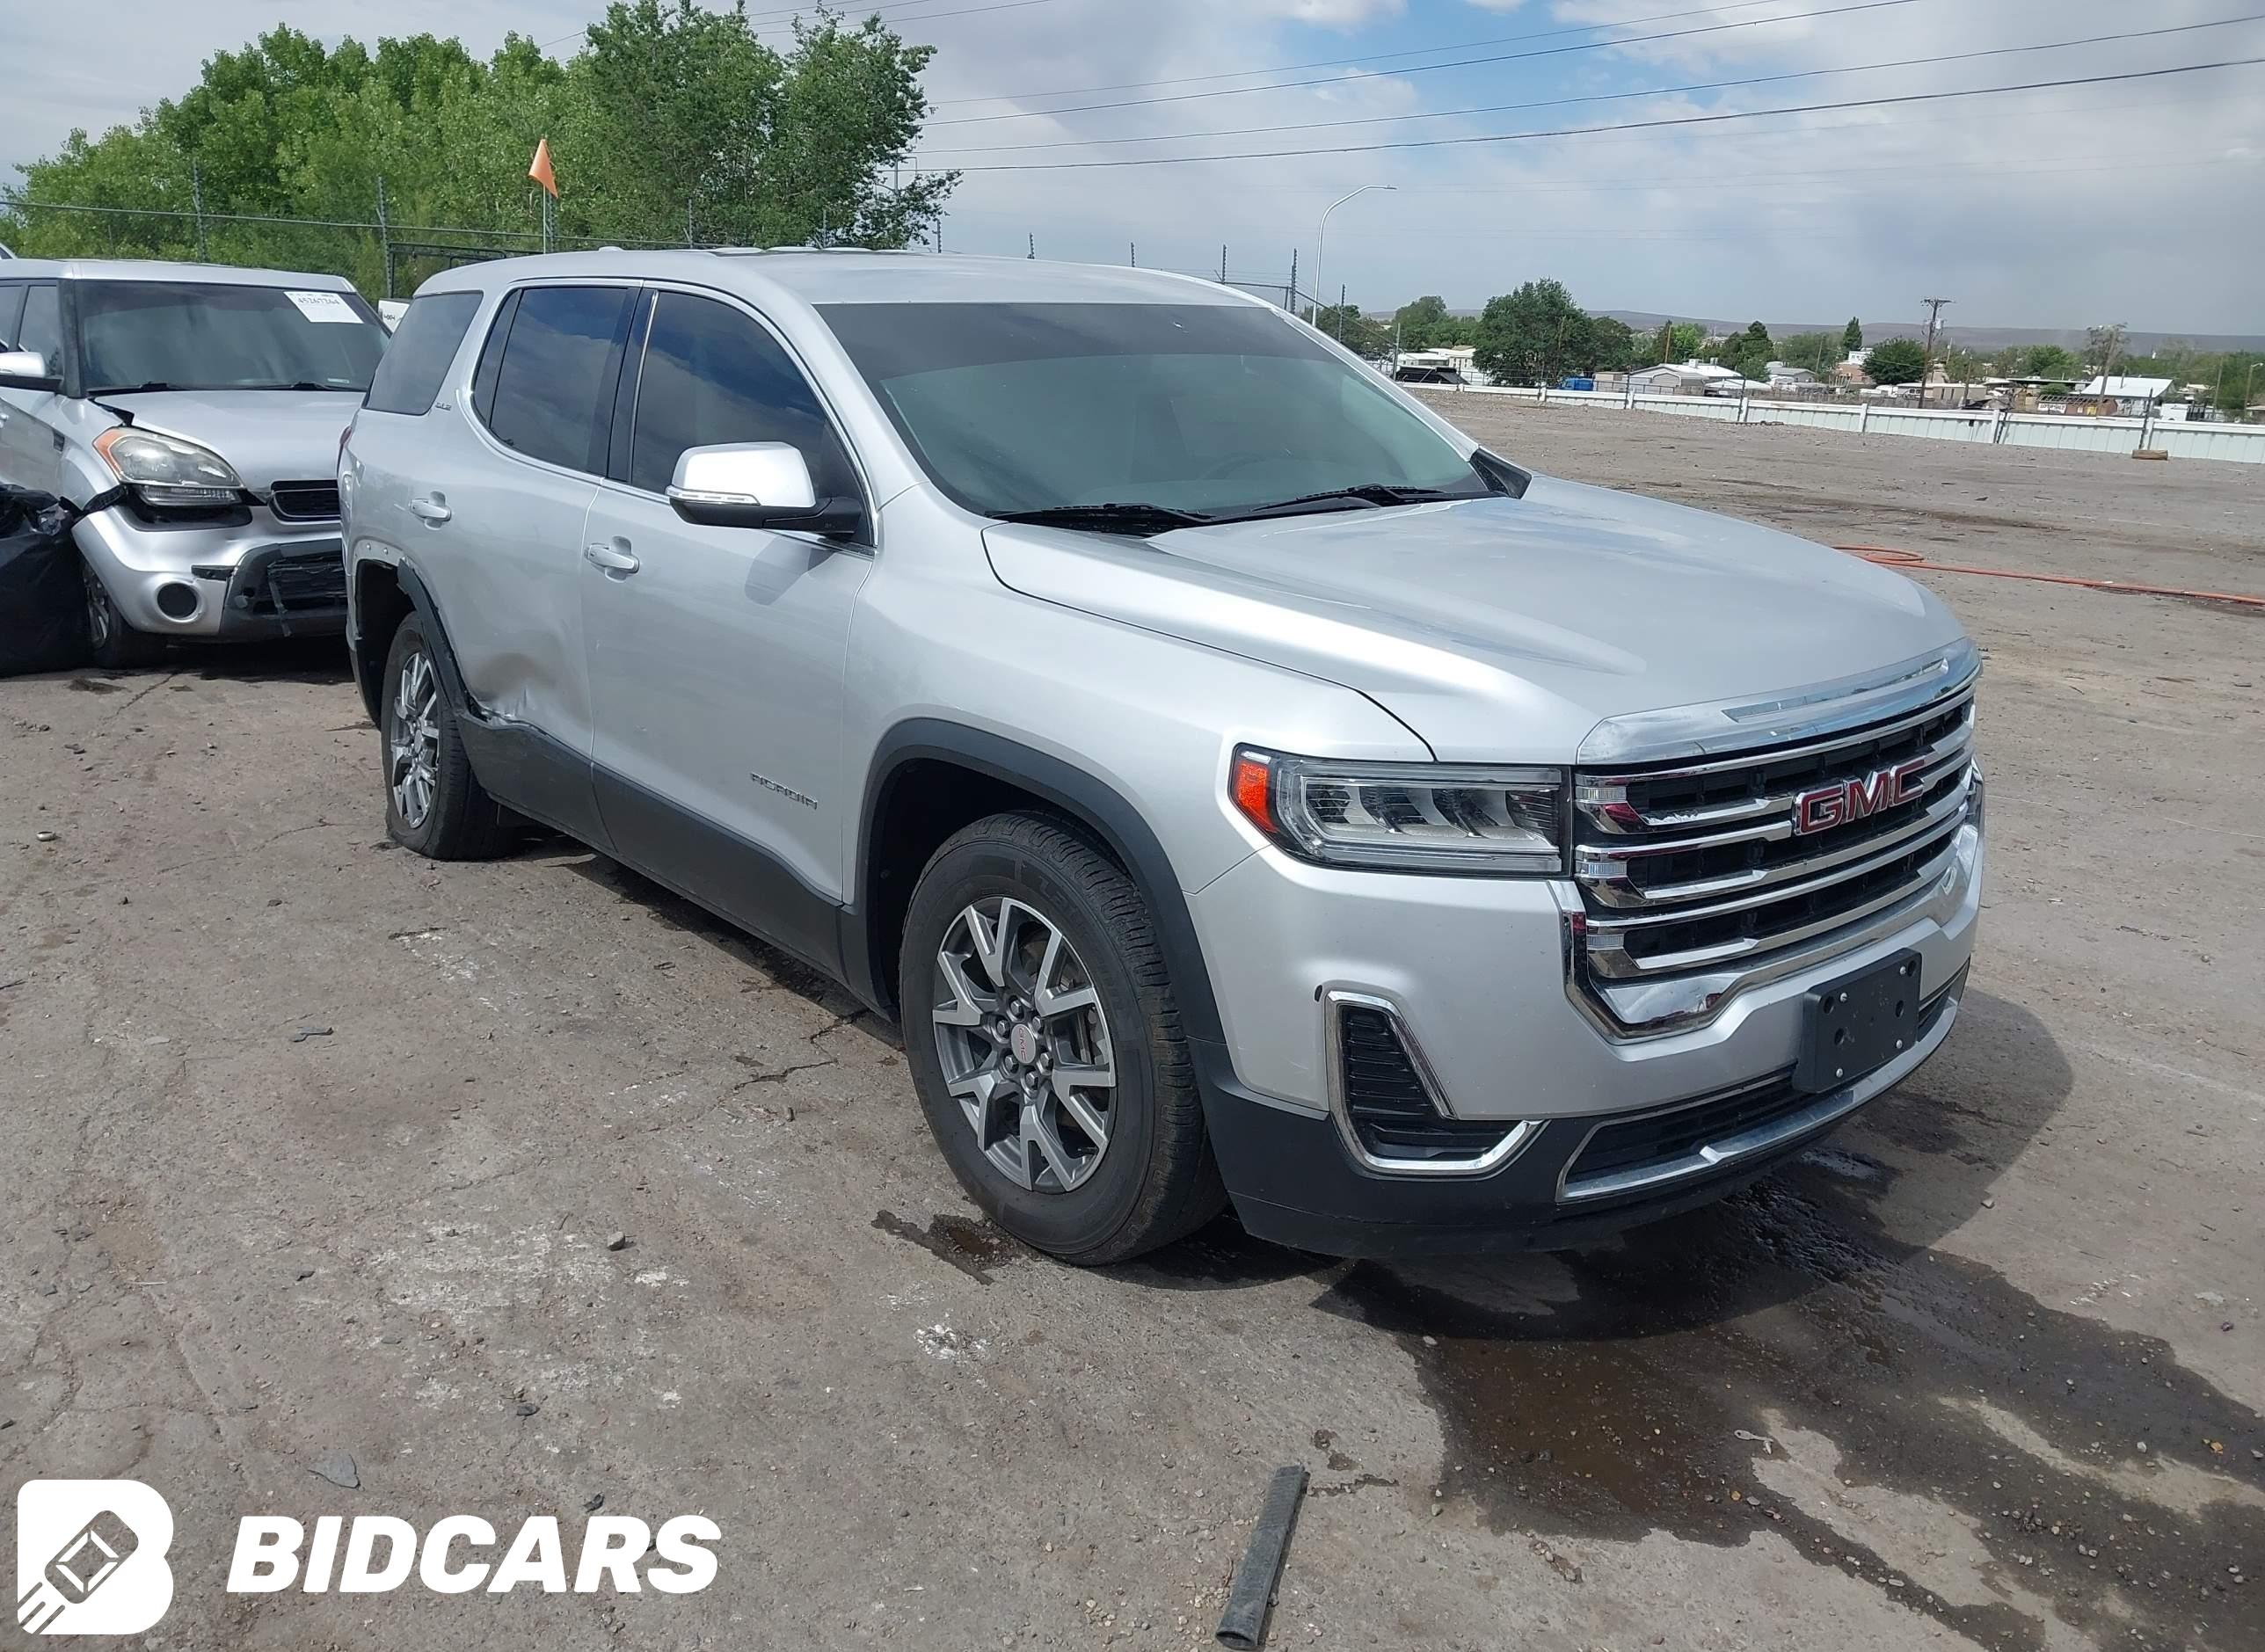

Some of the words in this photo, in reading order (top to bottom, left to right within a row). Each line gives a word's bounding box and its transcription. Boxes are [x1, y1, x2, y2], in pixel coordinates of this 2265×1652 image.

[750, 772, 818, 811] ACADIA
[1792, 754, 1926, 836] GMC
[1018, 1026, 1028, 1062] GMC
